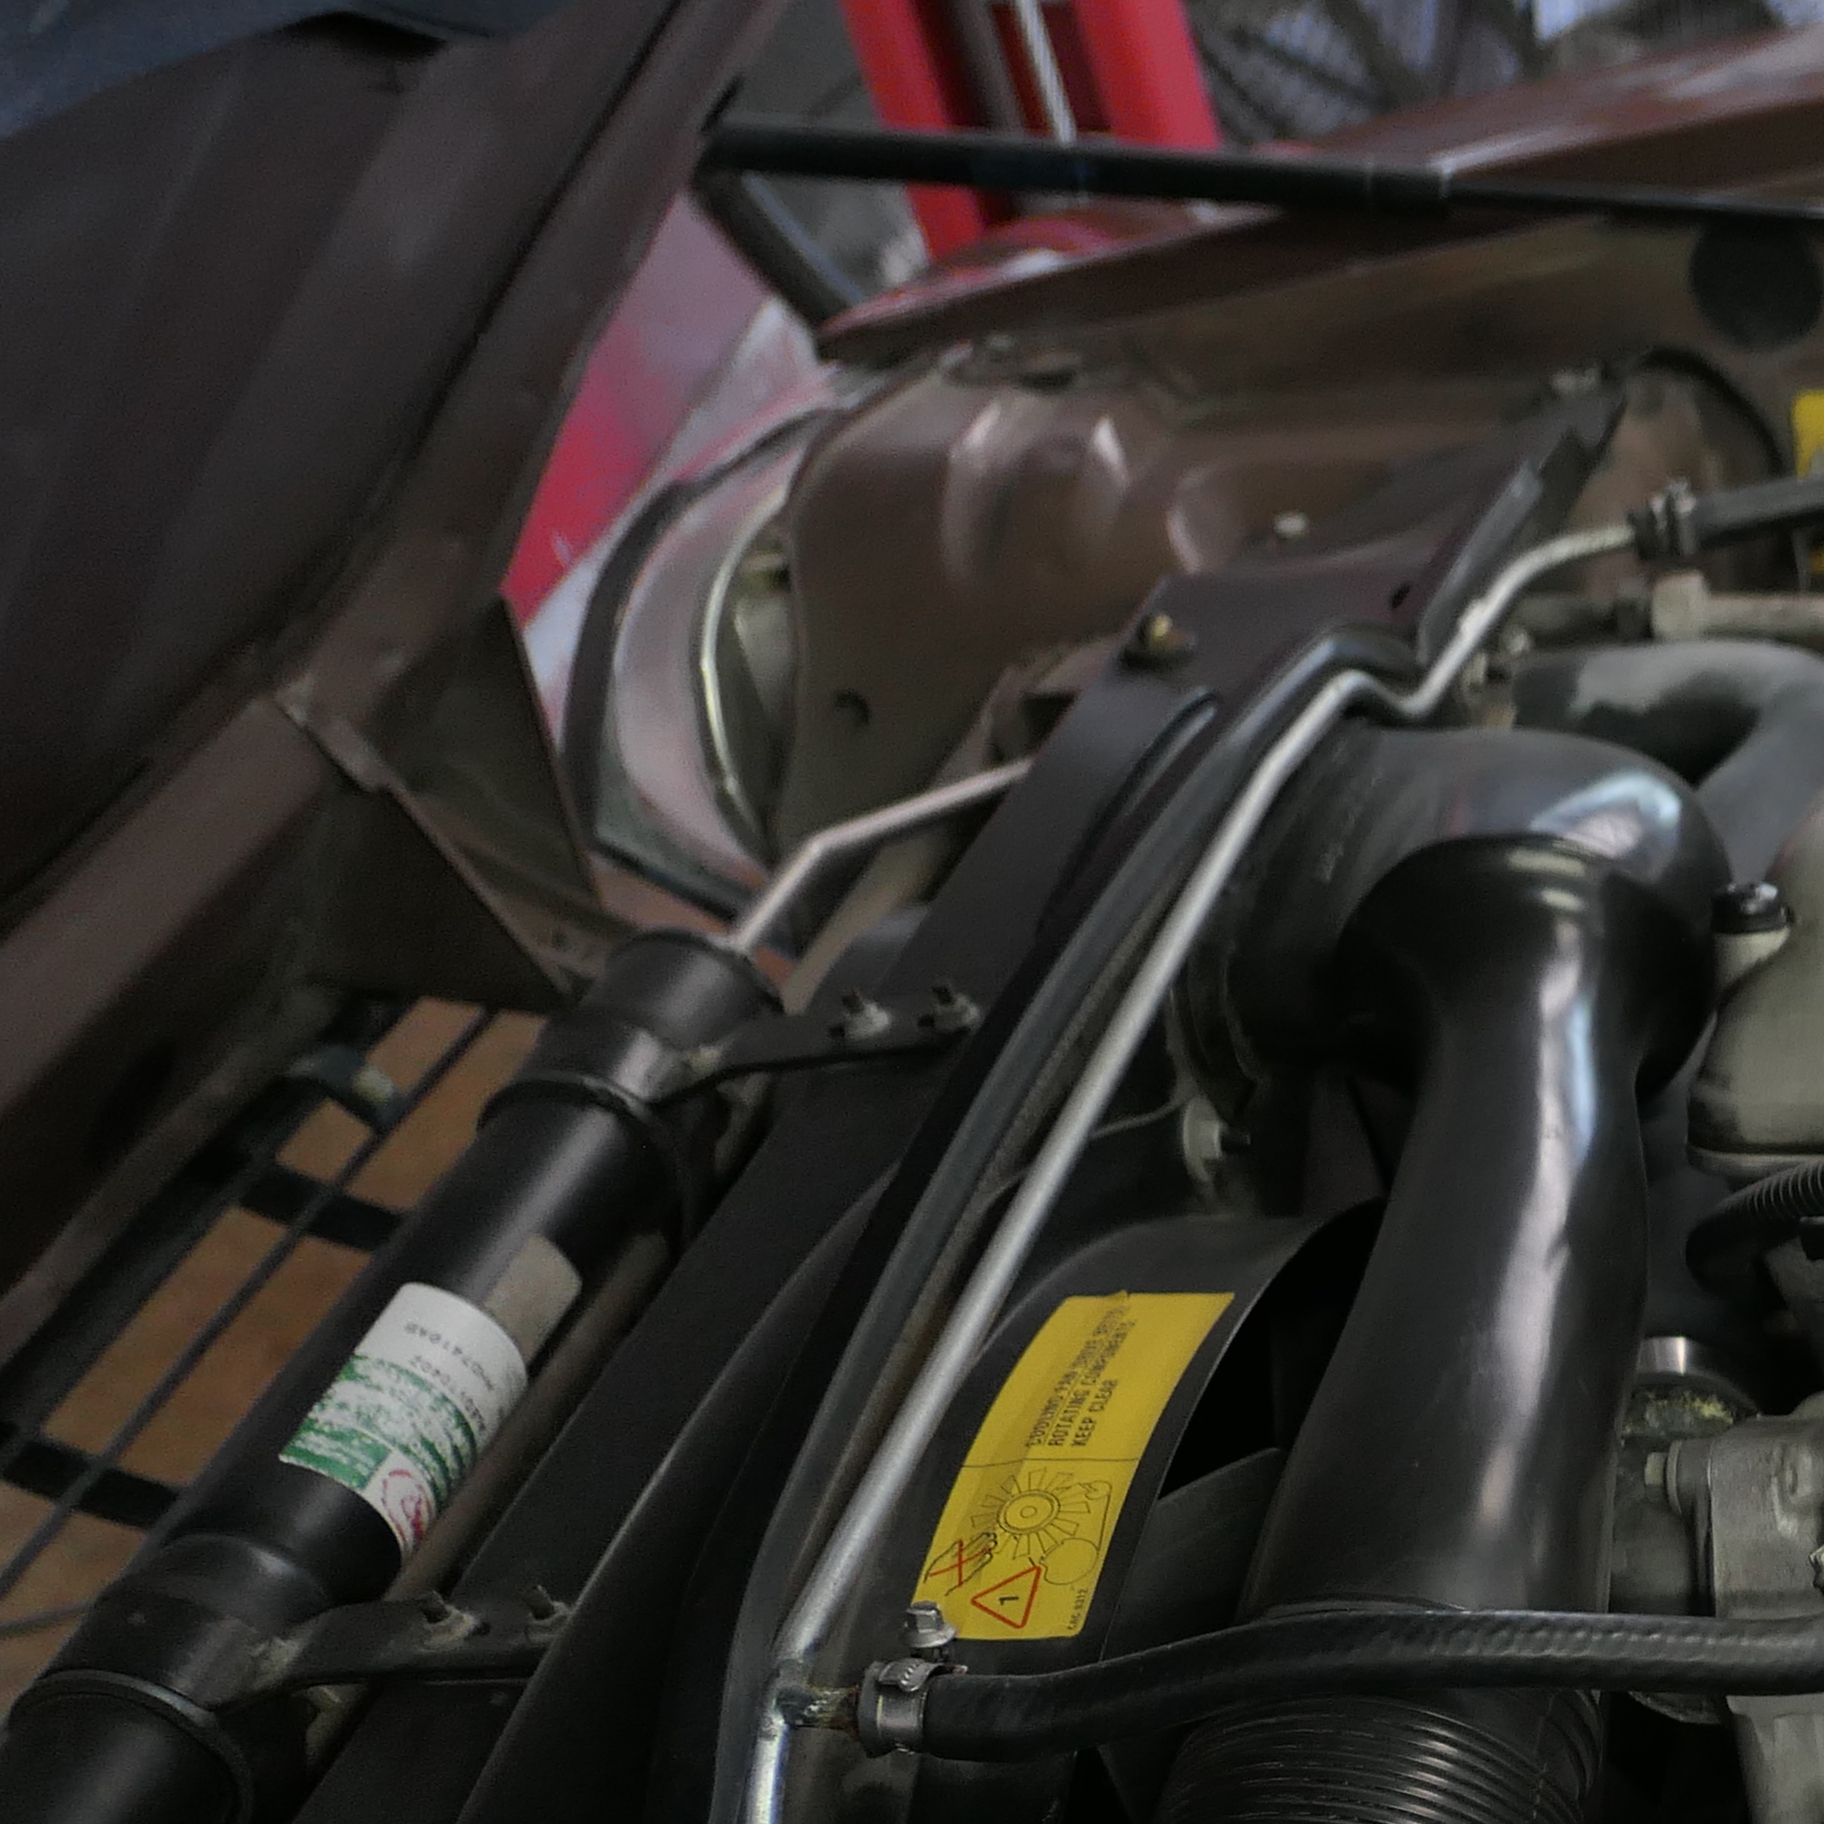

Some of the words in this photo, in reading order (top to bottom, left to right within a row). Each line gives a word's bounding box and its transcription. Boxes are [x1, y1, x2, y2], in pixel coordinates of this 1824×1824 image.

[1048, 1388, 1090, 1444] ROTATING
[1071, 1416, 1096, 1445] KEEP
[1089, 1379, 1117, 1411] CLEAR
